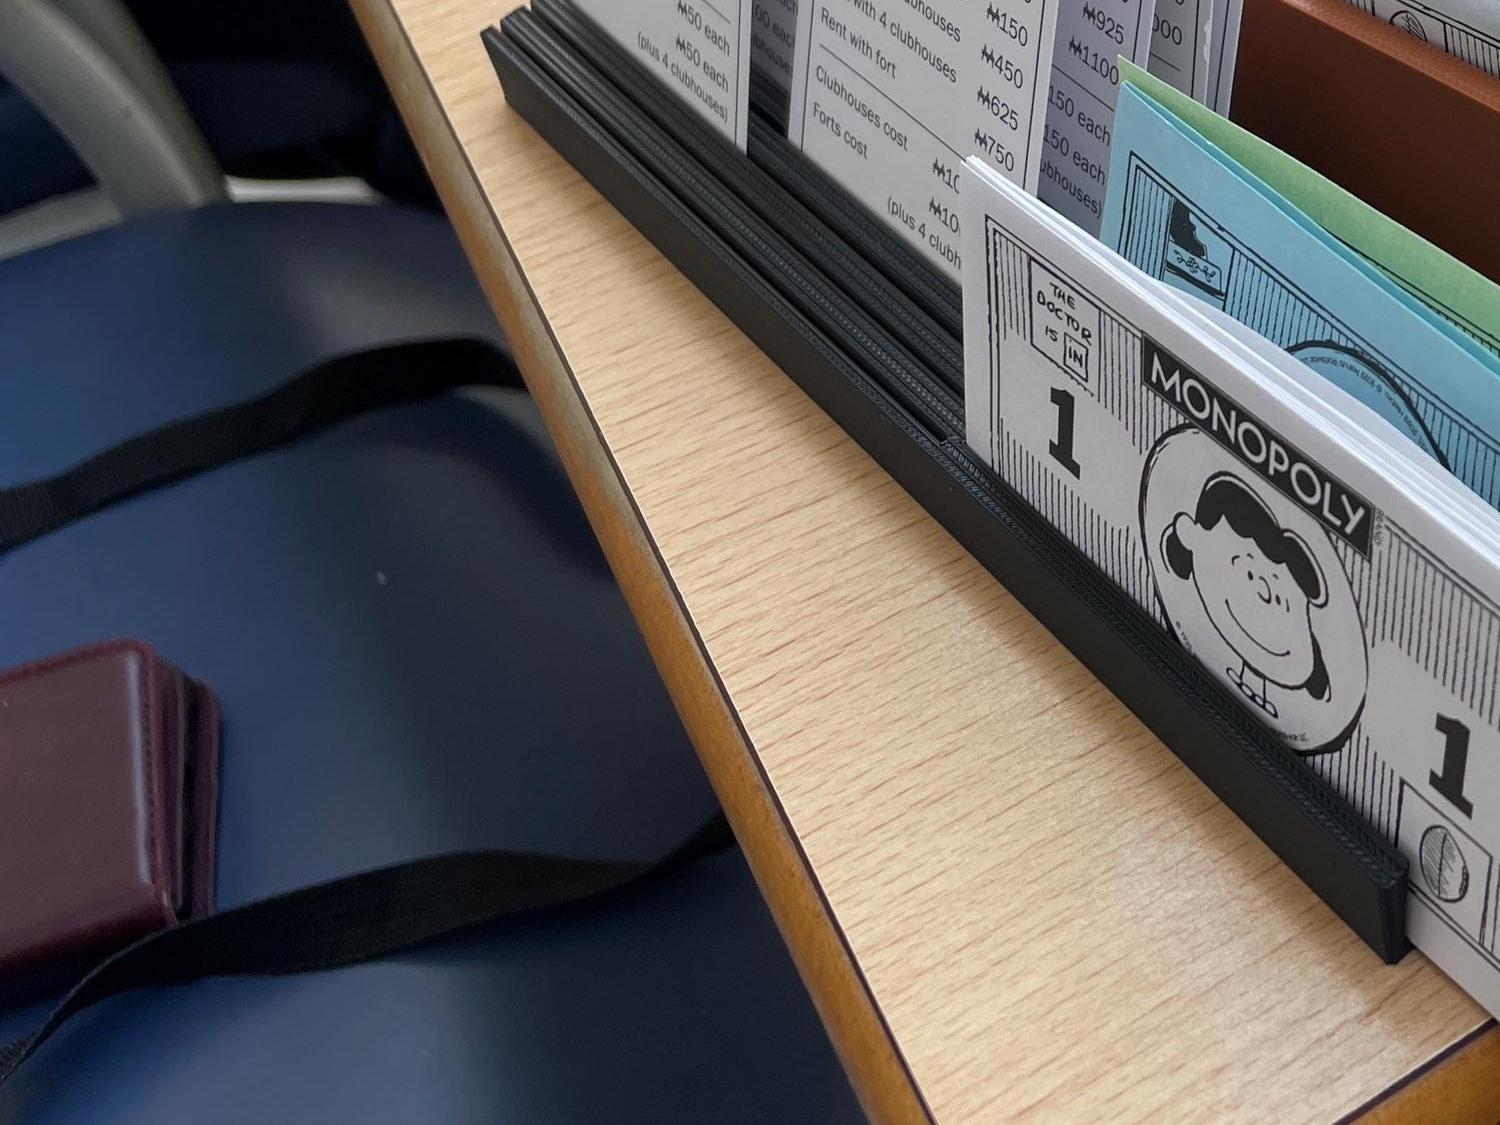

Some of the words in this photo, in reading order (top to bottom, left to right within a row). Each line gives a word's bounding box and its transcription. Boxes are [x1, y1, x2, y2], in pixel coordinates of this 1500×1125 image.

[704, 24, 730, 57] each
[821, 7, 847, 40] Rent
[850, 30, 873, 61] with
[876, 49, 896, 79] fort
[879, 11, 887, 29] 4
[890, 19, 957, 84] clubhouses
[662, 52, 669, 69] 4
[671, 61, 728, 124] clubhouses)
[703, 60, 729, 93] each
[813, 101, 841, 138] Forts
[843, 129, 868, 160] cost
[816, 65, 881, 128] Clubhouses
[883, 122, 908, 151] cost
[1047, 85, 1074, 118] 150
[1078, 112, 1111, 148] each
[1043, 125, 1069, 158] 150
[1073, 152, 1106, 187] each
[887, 196, 915, 231] (plus
[919, 223, 926, 240] 4
[1037, 290, 1092, 346] DOCTOR
[1049, 282, 1076, 310] THE
[1045, 325, 1058, 342] IS
[1068, 347, 1083, 368] IN
[1048, 386, 1081, 480] 1
[1150, 351, 1365, 535] MONOPOLY
[1429, 712, 1474, 820] 1
